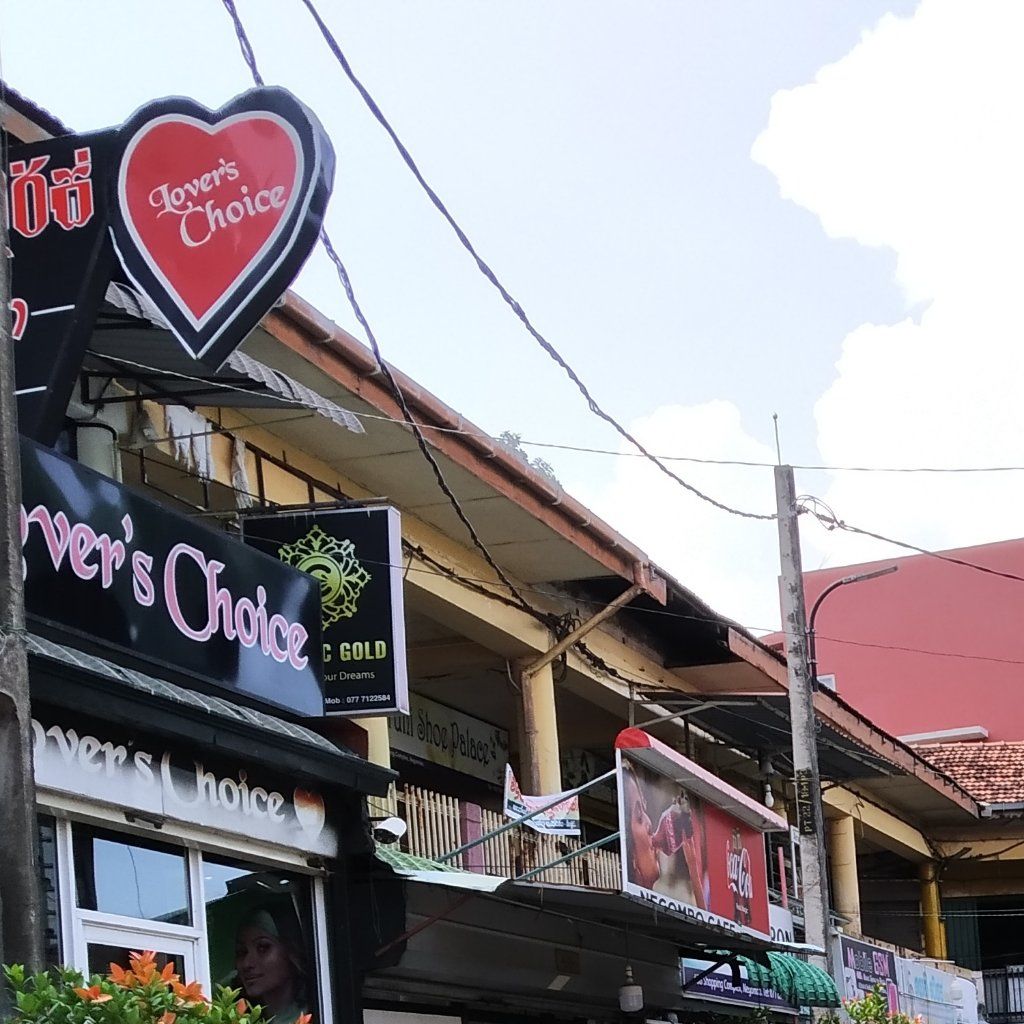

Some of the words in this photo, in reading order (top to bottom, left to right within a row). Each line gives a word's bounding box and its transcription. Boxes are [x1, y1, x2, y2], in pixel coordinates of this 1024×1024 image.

[149, 157, 240, 218] Lover's
[180, 185, 287, 247] Choice
[20, 503, 155, 607] ver's
[164, 542, 309, 672] Choice
[339, 640, 387, 661] GOLD
[339, 671, 376, 681] Dreams
[360, 694, 391, 702] 7122584
[450, 720, 490, 768] Palace
